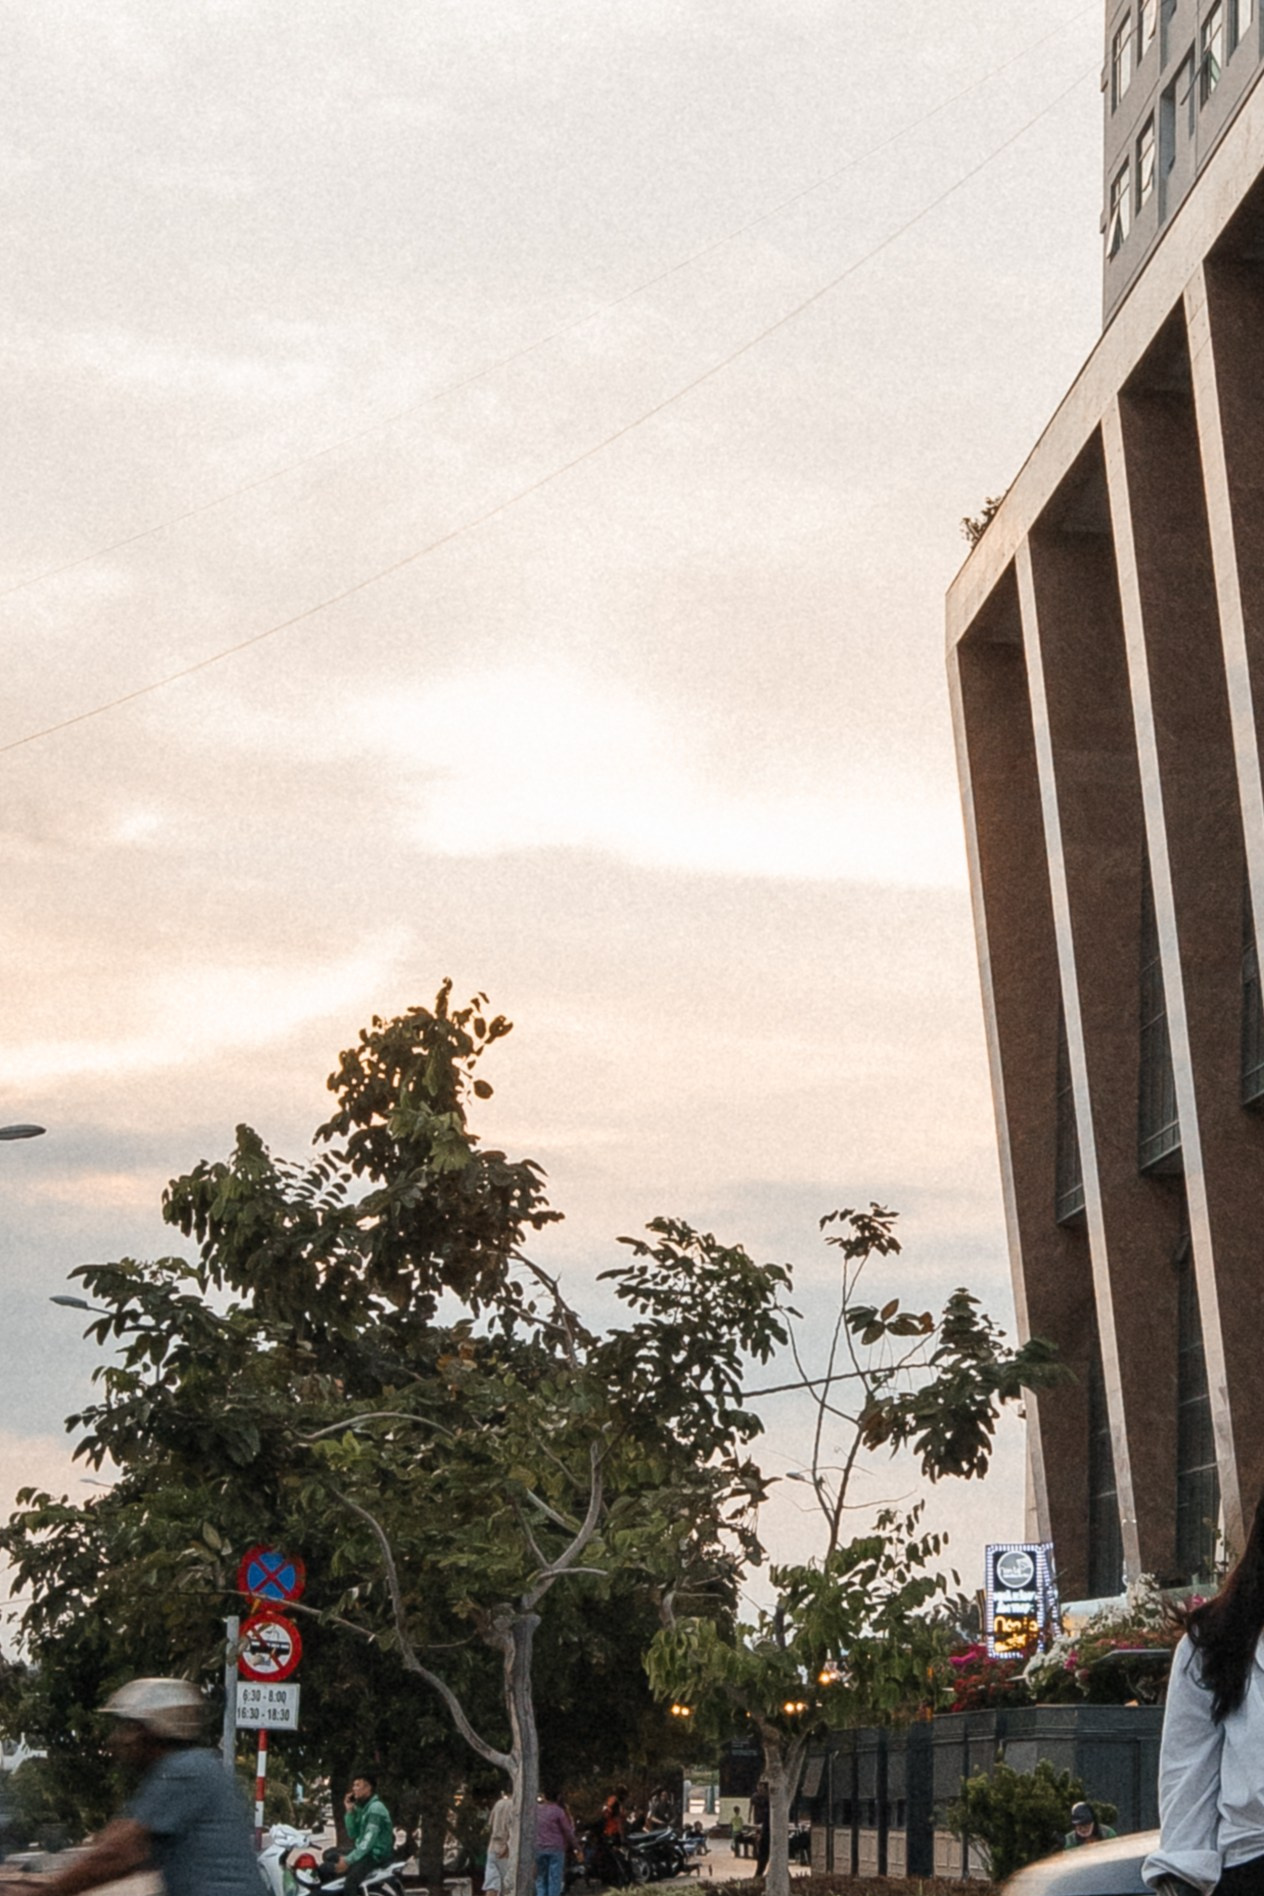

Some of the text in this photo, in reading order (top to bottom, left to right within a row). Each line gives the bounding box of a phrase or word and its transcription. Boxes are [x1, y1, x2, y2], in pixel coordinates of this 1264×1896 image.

[242, 1689, 261, 1702] 6:30
[268, 1689, 287, 1702] 8:00
[237, 1706, 259, 1719] 16:30
[267, 1708, 290, 1721] 18:30
